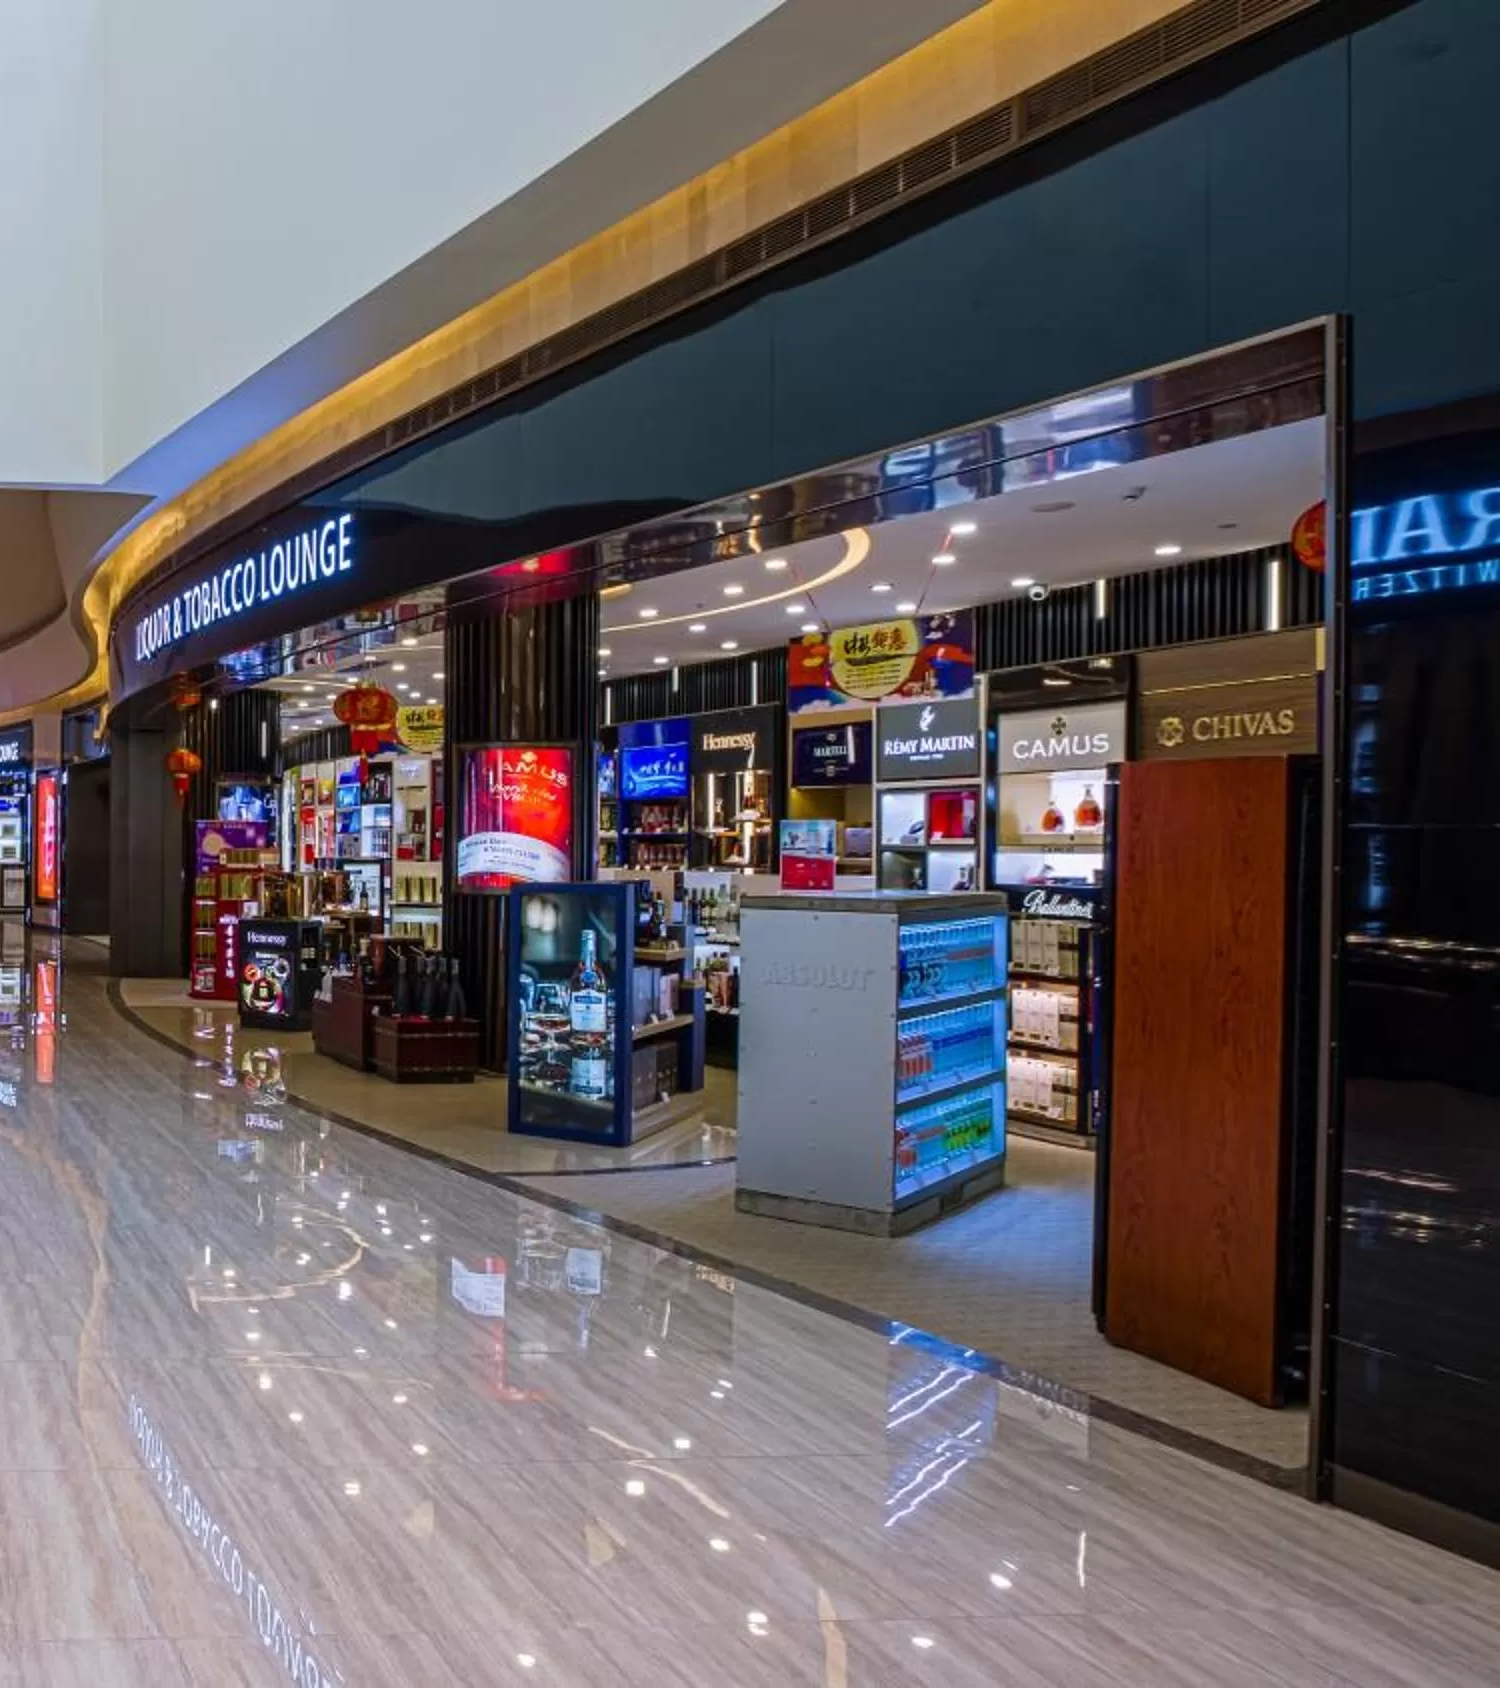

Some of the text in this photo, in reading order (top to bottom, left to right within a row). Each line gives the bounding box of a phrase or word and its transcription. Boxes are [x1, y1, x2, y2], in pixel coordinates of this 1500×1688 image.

[173, 597, 183, 640] &
[183, 557, 257, 633] TOBACCO
[260, 513, 352, 600] LOUNGE
[1192, 709, 1295, 741] CHIVAS
[703, 732, 756, 750] Hennessy
[884, 735, 976, 755] RÉMY MARTIN
[1012, 733, 1110, 759] CAMUS
